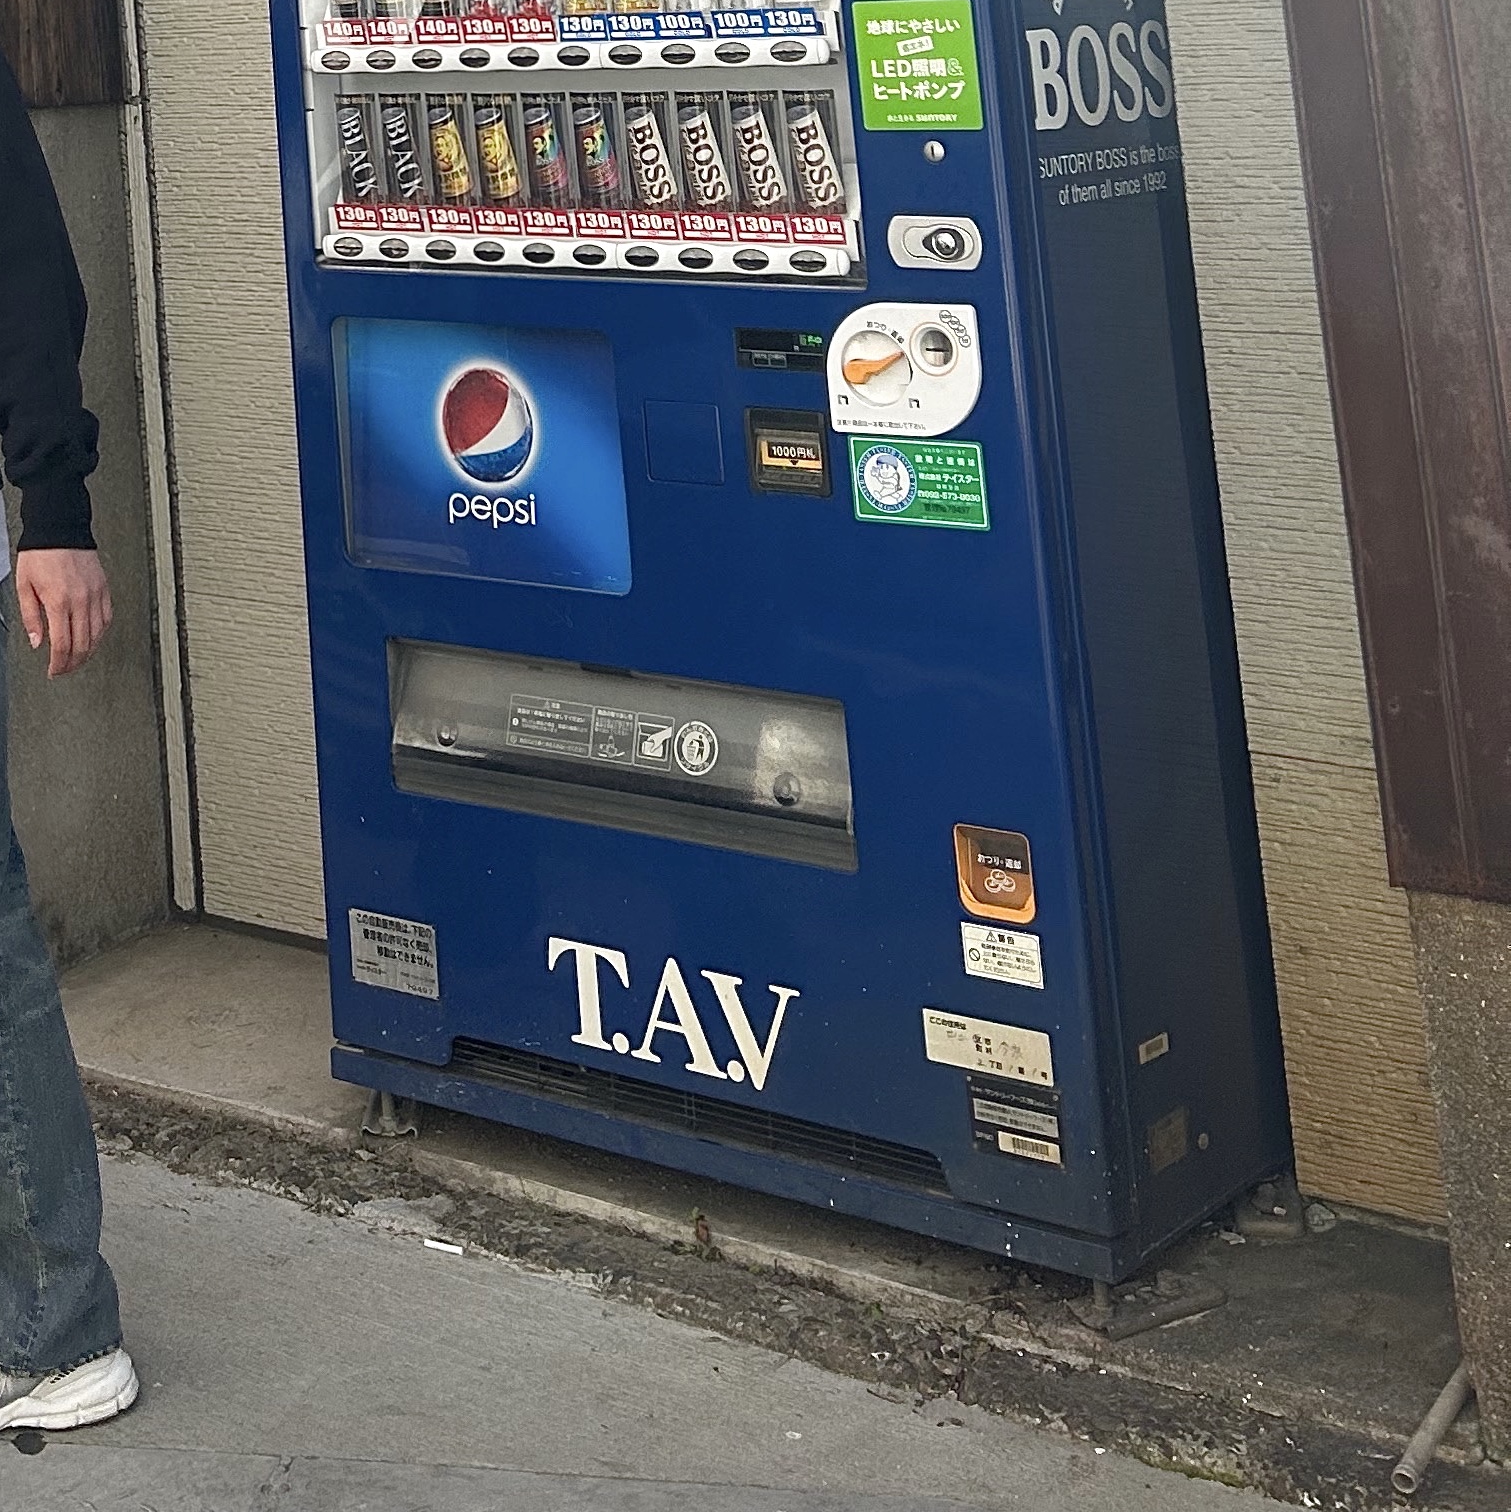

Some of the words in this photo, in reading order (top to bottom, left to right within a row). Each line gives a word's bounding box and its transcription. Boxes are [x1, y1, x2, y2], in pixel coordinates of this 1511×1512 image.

[510, 17, 553, 33] 130円
[561, 16, 604, 31] 130円
[608, 15, 654, 30] 130円
[656, 13, 704, 29] 100円
[713, 11, 760, 28] 100円
[765, 9, 815, 26] 130円
[324, 22, 363, 36] 140円
[368, 21, 410, 35] 140円
[416, 19, 458, 34] 140円
[463, 19, 506, 34] 130円
[866, 18, 961, 35] 地球にやさしい
[1026, 19, 1173, 131] BOSS
[873, 80, 966, 100] ヒートポンプ
[338, 115, 379, 198] BLACK
[383, 115, 424, 199] BLACK
[633, 120, 671, 200] BOSS
[687, 120, 726, 200] BOSS
[741, 120, 781, 201] BOSS
[797, 120, 837, 202] BOSS
[1039, 152, 1094, 179] SUNTORY
[1095, 147, 1128, 171] BOSS
[1129, 146, 1139, 166] is
[1140, 144, 1156, 165] the
[1058, 184, 1069, 206] of
[1071, 182, 1098, 205] them
[1100, 178, 1112, 200] all
[1114, 178, 1141, 197] since
[337, 207, 376, 221] 130円
[380, 207, 420, 223] 130円
[429, 209, 470, 224] 130円
[475, 210, 519, 225] 130円
[524, 211, 568, 227] 130円
[577, 213, 622, 229] 130円
[628, 213, 675, 230] 130円
[681, 214, 728, 231] 130円
[736, 215, 783, 233] 130円
[791, 216, 841, 234] 130円
[449, 492, 536, 528] pepsi
[548, 936, 800, 1091] T.A.V
